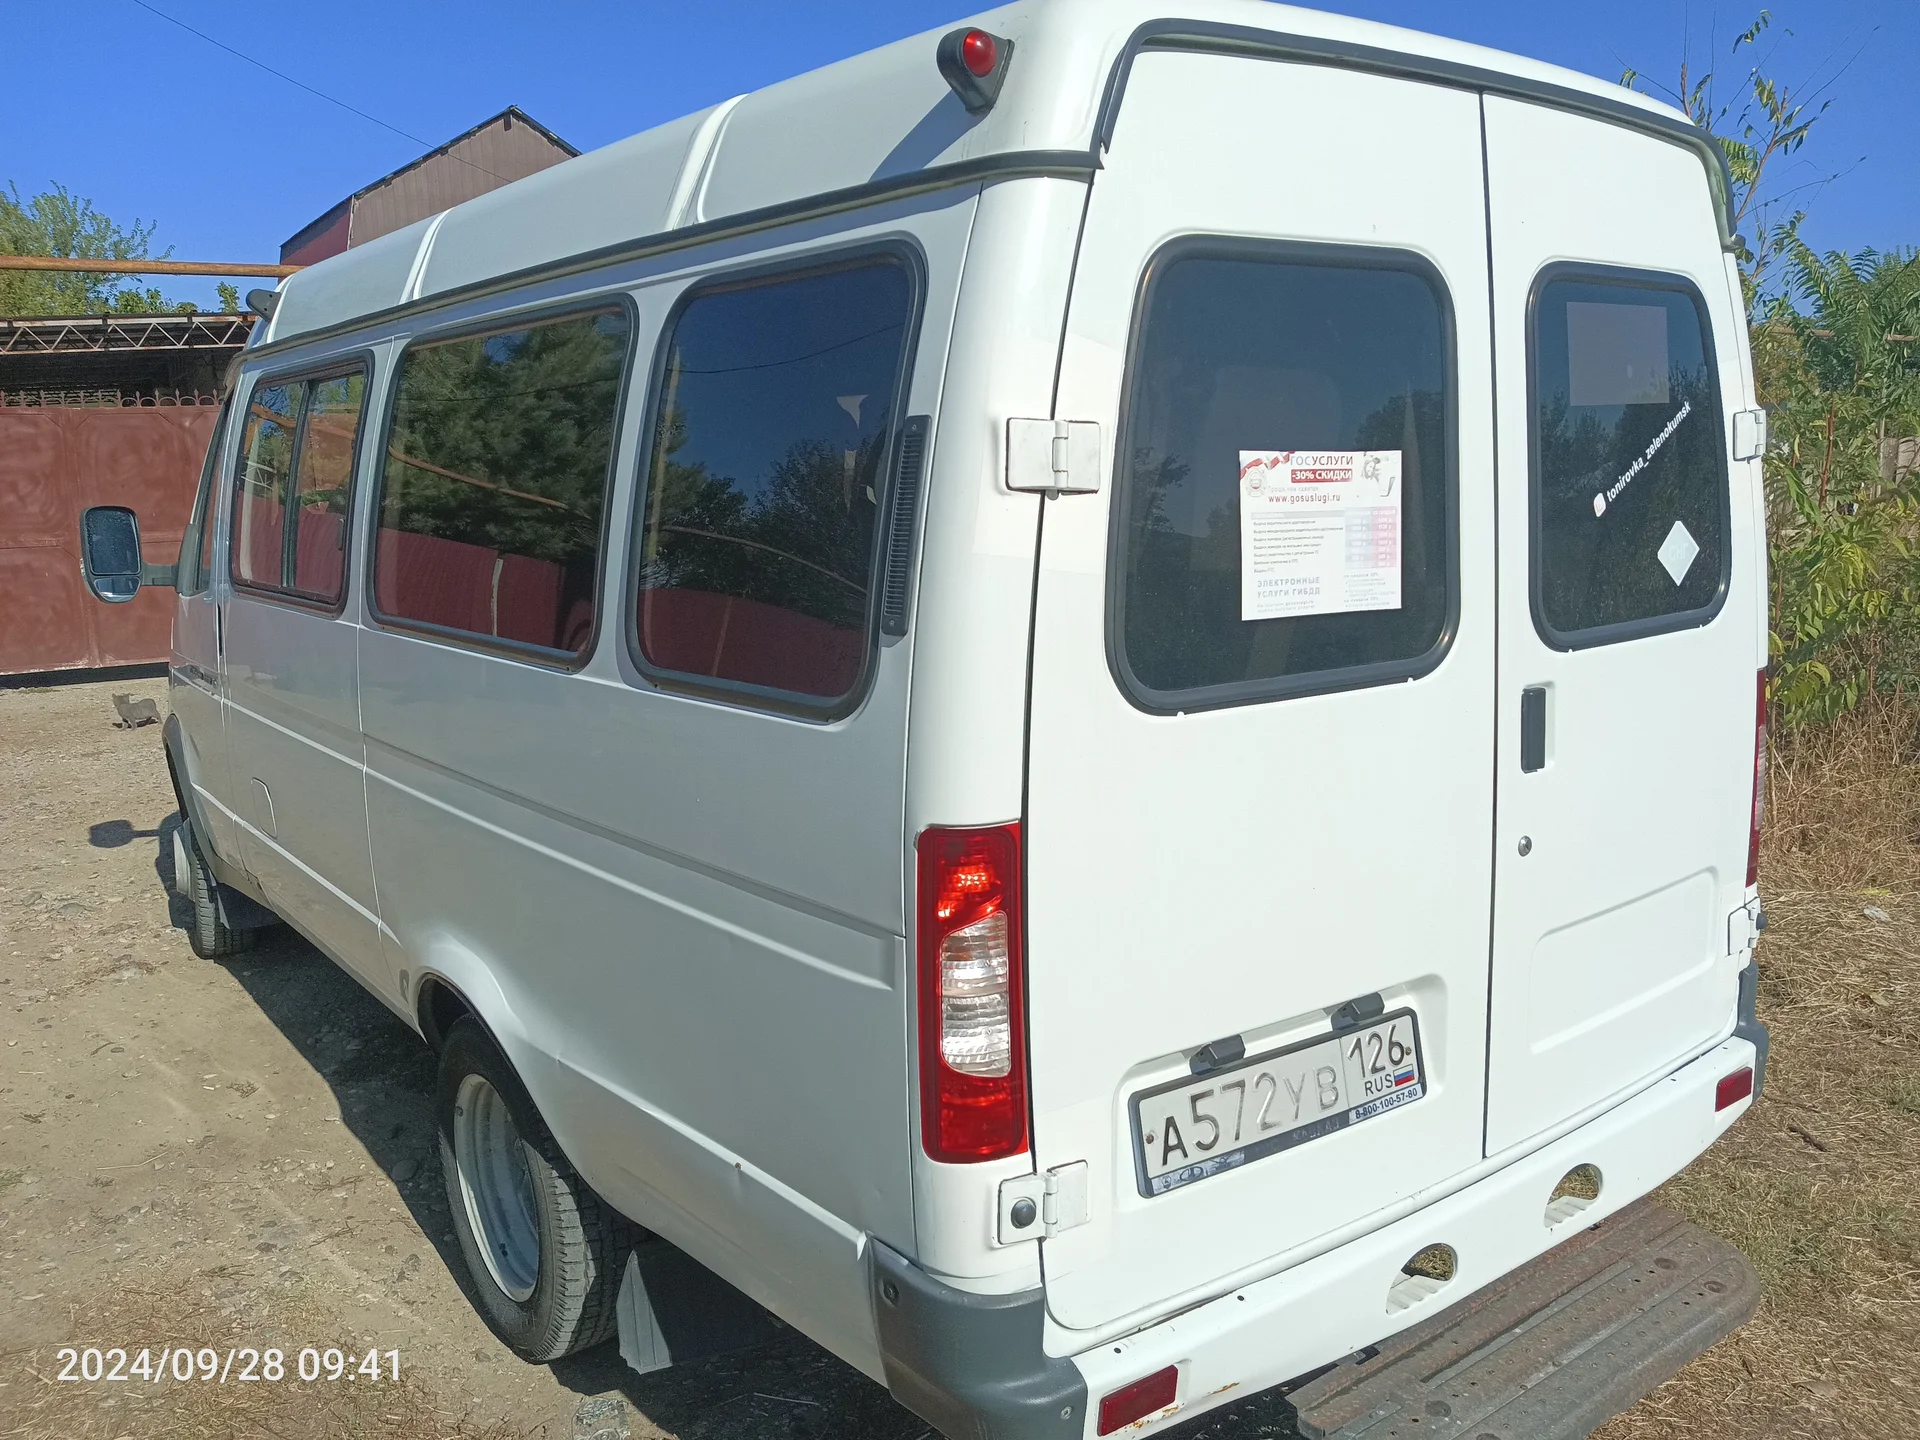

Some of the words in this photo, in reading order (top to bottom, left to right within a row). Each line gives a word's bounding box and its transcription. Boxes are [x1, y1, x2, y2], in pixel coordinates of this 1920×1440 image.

[1606, 399, 1692, 502] tonirovka_zelenokumsk
[1290, 455, 1354, 465] ГОСУСЛУГИ
[1291, 471, 1314, 481] -30%
[1315, 469, 1352, 481] СКИДКИ
[1268, 493, 1341, 504] www.gosuslugi.ru
[1257, 576, 1320, 588] ЭЛЕКТРОННЫЕ
[1257, 588, 1290, 599] УСЛУГИ
[1292, 586, 1321, 596] ГИБДД
[1346, 1024, 1405, 1078] 126
[1364, 1077, 1394, 1097] RUS
[1355, 1088, 1418, 1120] 8-800-100-57-80
